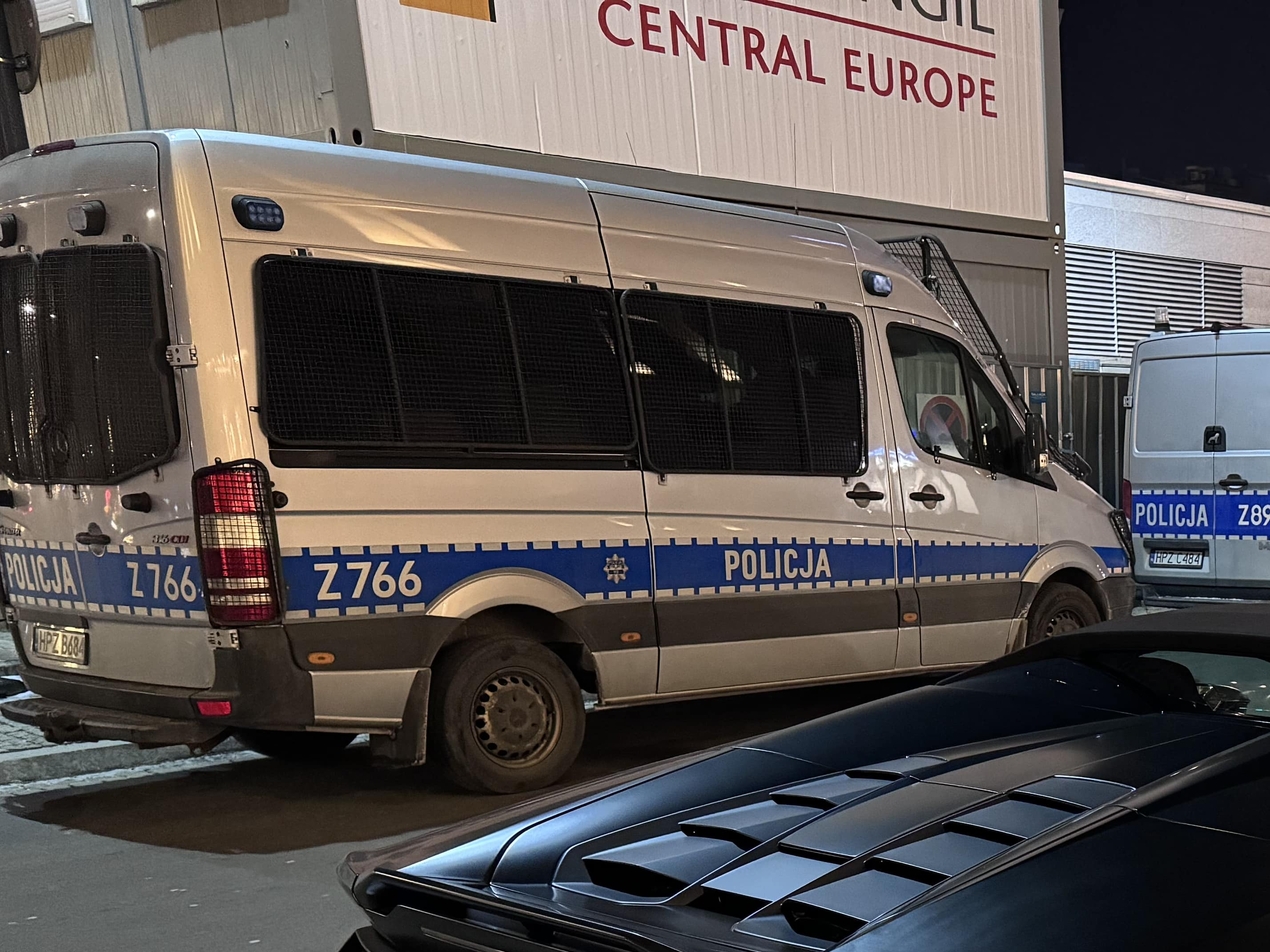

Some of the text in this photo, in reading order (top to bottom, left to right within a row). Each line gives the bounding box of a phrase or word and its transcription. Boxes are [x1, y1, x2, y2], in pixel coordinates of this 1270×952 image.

[598, 0, 826, 85] CENTRAL
[844, 48, 998, 118] EUROPE
[1135, 502, 1209, 527] POLICJA
[725, 548, 832, 581] POLICJA
[1155, 551, 1201, 565] HPZ C484
[4, 552, 78, 595] POLICJA
[39, 631, 59, 653] HPZ
